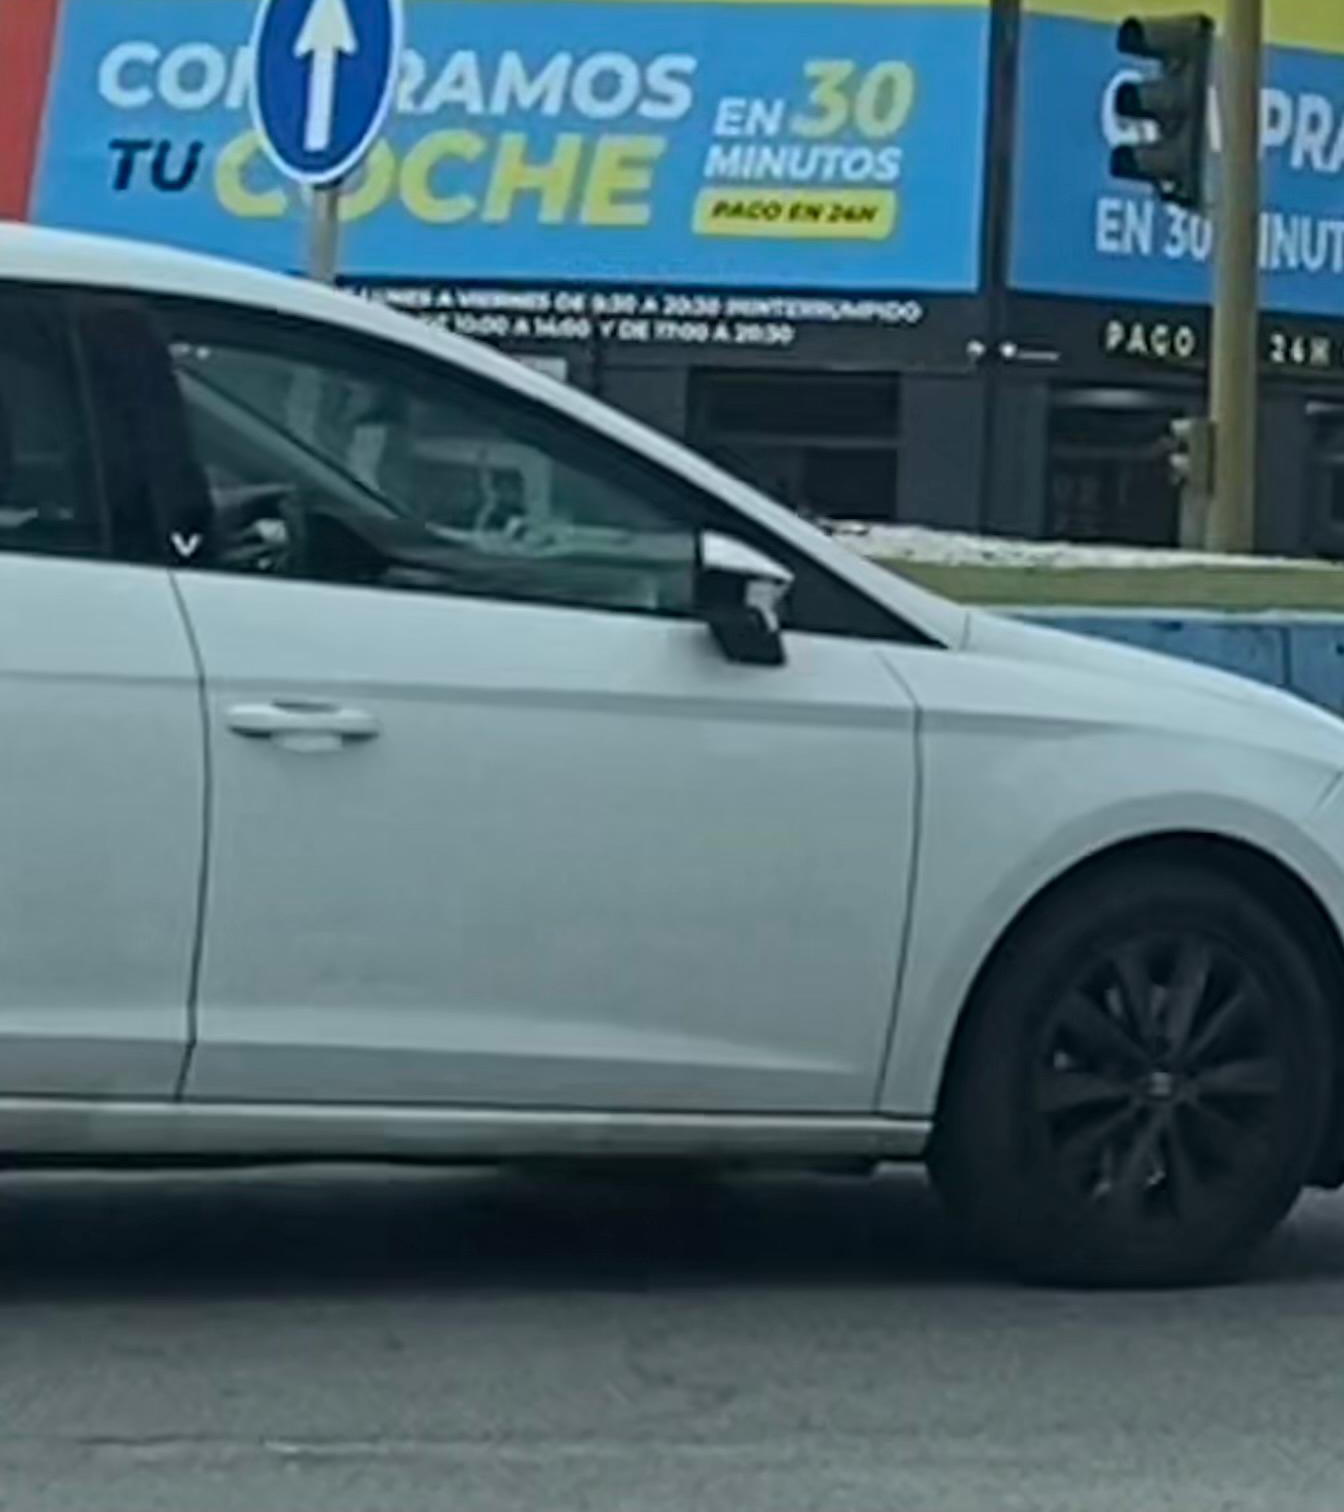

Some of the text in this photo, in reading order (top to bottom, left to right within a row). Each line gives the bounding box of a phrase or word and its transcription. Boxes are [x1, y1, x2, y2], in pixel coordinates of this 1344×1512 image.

[99, 41, 697, 120] CORAMOS
[713, 59, 915, 139] EN 30
[108, 126, 667, 226] TU COCHE
[703, 144, 903, 182] MINUTOS
[711, 200, 783, 222] PAGO
[788, 201, 822, 222] EN
[1096, 197, 1155, 256] EN
[1105, 319, 1196, 357] PAGO
